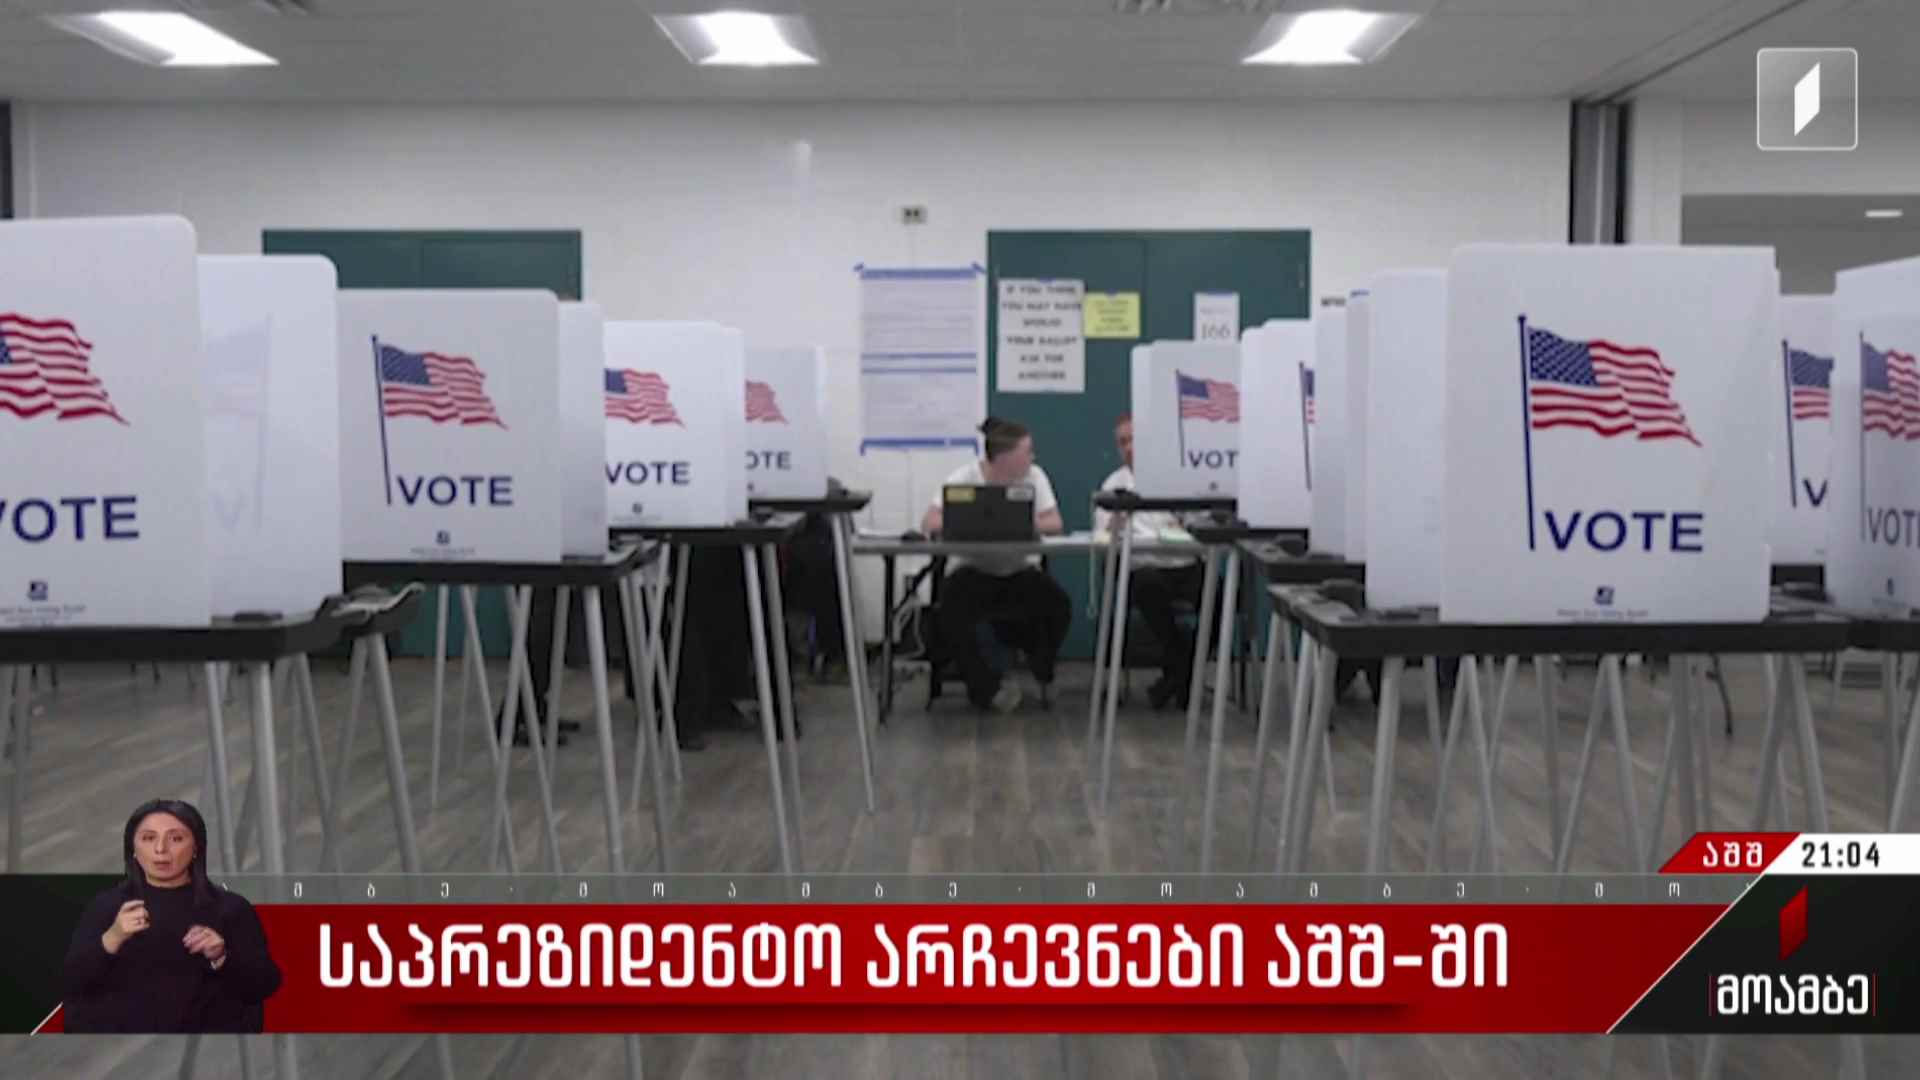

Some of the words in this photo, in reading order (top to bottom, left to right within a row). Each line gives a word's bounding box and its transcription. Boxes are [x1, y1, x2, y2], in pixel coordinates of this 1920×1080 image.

[397, 475, 514, 506] VOTE
[605, 461, 690, 485] VOTE
[0, 495, 140, 542] OTE
[1544, 510, 1704, 552] VOTE
[1867, 507, 1920, 549] VOT
